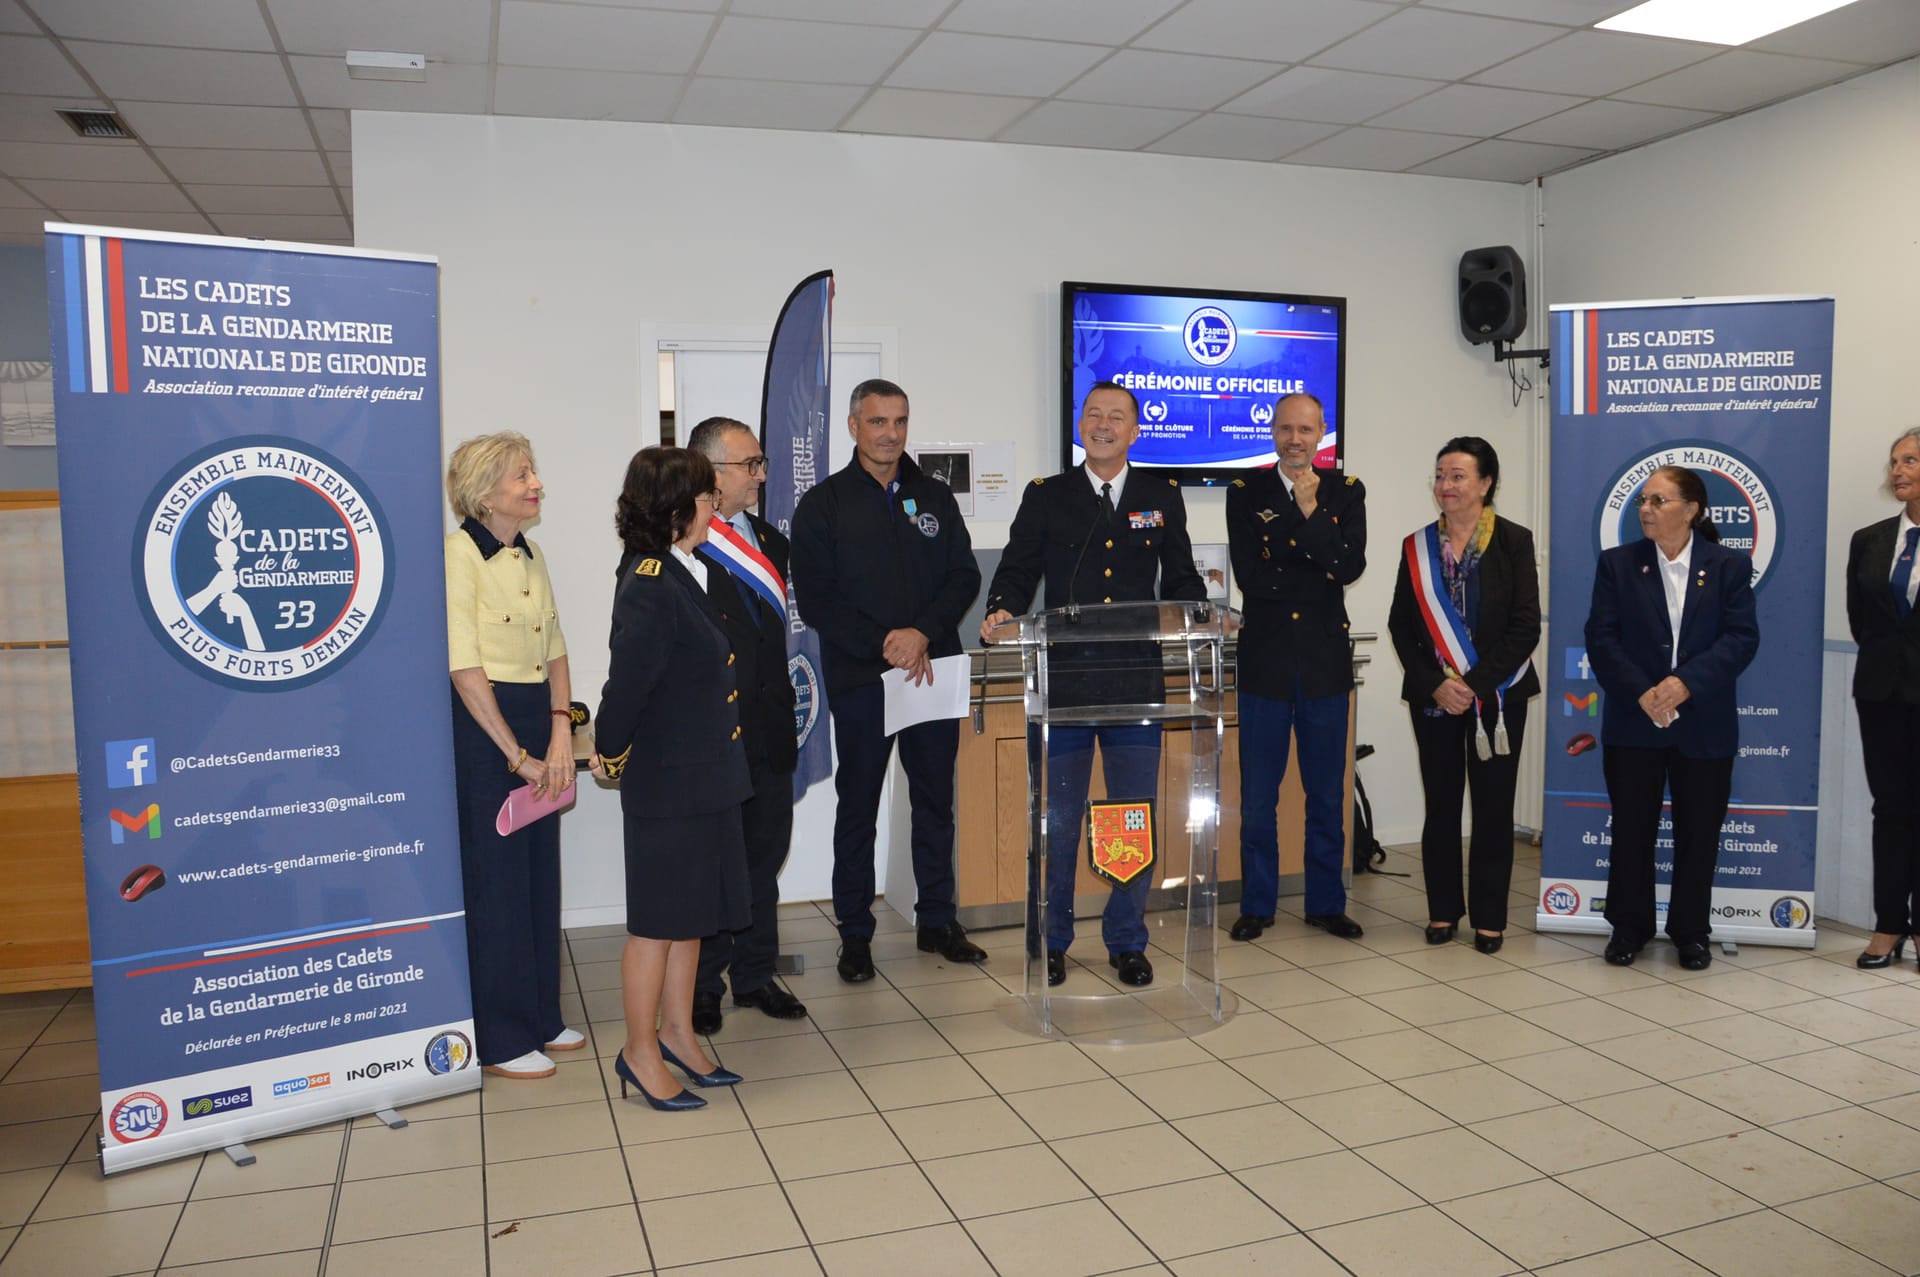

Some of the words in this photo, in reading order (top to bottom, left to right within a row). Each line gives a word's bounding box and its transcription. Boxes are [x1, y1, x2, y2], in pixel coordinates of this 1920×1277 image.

[139, 276, 188, 301] LES
[194, 279, 291, 307] CADETS
[141, 311, 176, 335] DE
[181, 314, 217, 337] LA
[222, 315, 393, 345] GENDARMERIE
[1606, 332, 1641, 349] LES
[1643, 328, 1716, 347] CADETS
[142, 345, 286, 373] NATIONALE
[290, 351, 324, 375] DE
[326, 352, 427, 377] GIRONDE
[1606, 354, 1631, 372] DE
[1633, 353, 1659, 371] LA
[1662, 350, 1795, 370] GENDARMERIE
[143, 378, 234, 397] Association
[235, 384, 305, 398] reconnue
[307, 382, 369, 400] d'intérêt
[370, 385, 424, 404] général
[1112, 371, 1213, 391] CÉRÉMONIE
[1216, 378, 1305, 394] OFFICIELLE
[1606, 376, 1709, 396] NATIONALE
[1711, 375, 1736, 393] DE
[1740, 373, 1822, 392] GIRONDE
[1606, 401, 1669, 414] Association
[1669, 401, 1723, 413] reconnue
[1724, 398, 1772, 411] d'intérêt
[1772, 397, 1819, 413] général
[155, 453, 247, 536] ENSEMBLE
[257, 451, 374, 535] MAINTENANT
[1609, 453, 1676, 511] ENSEMBLE
[1683, 450, 1770, 512] MAINTENANT
[239, 528, 349, 553] CADETS
[254, 551, 277, 571] de
[282, 551, 301, 571] la
[238, 567, 355, 588] GENDARMERIE
[274, 600, 317, 630] 33
[170, 616, 220, 663] PLUS
[223, 654, 295, 677] FORTS
[301, 606, 368, 669] DEMAIN
[170, 744, 341, 773] @CadetsGendarmerie33
[174, 790, 406, 828] cadetsgendarmerie33@gmail.com
[1582, 831, 1598, 846] de
[1720, 820, 1756, 834] adets
[1724, 839, 1779, 853] Gironde
[178, 839, 425, 884] www.cadets-gendarmerie-gironde.fr
[1738, 866, 1762, 875] 2021
[1546, 894, 1577, 909] SNU
[1711, 905, 1762, 918] NORIX
[192, 964, 300, 995] Association
[303, 957, 333, 976] des
[336, 947, 393, 970] Cadets
[160, 1007, 183, 1027] de
[187, 1003, 205, 1022] la
[209, 984, 330, 1017] Gendarmerie
[333, 976, 353, 996] de
[356, 965, 425, 990] Gironde
[185, 1035, 242, 1055] Déclarée
[245, 1031, 261, 1044] en
[264, 1018, 328, 1041] Préfecture
[330, 1014, 342, 1028] le
[343, 1013, 352, 1025] 8
[354, 1007, 377, 1022] mai
[379, 1002, 408, 1018] 2021
[346, 1057, 415, 1081] INORIX
[115, 1105, 163, 1133] SNU
